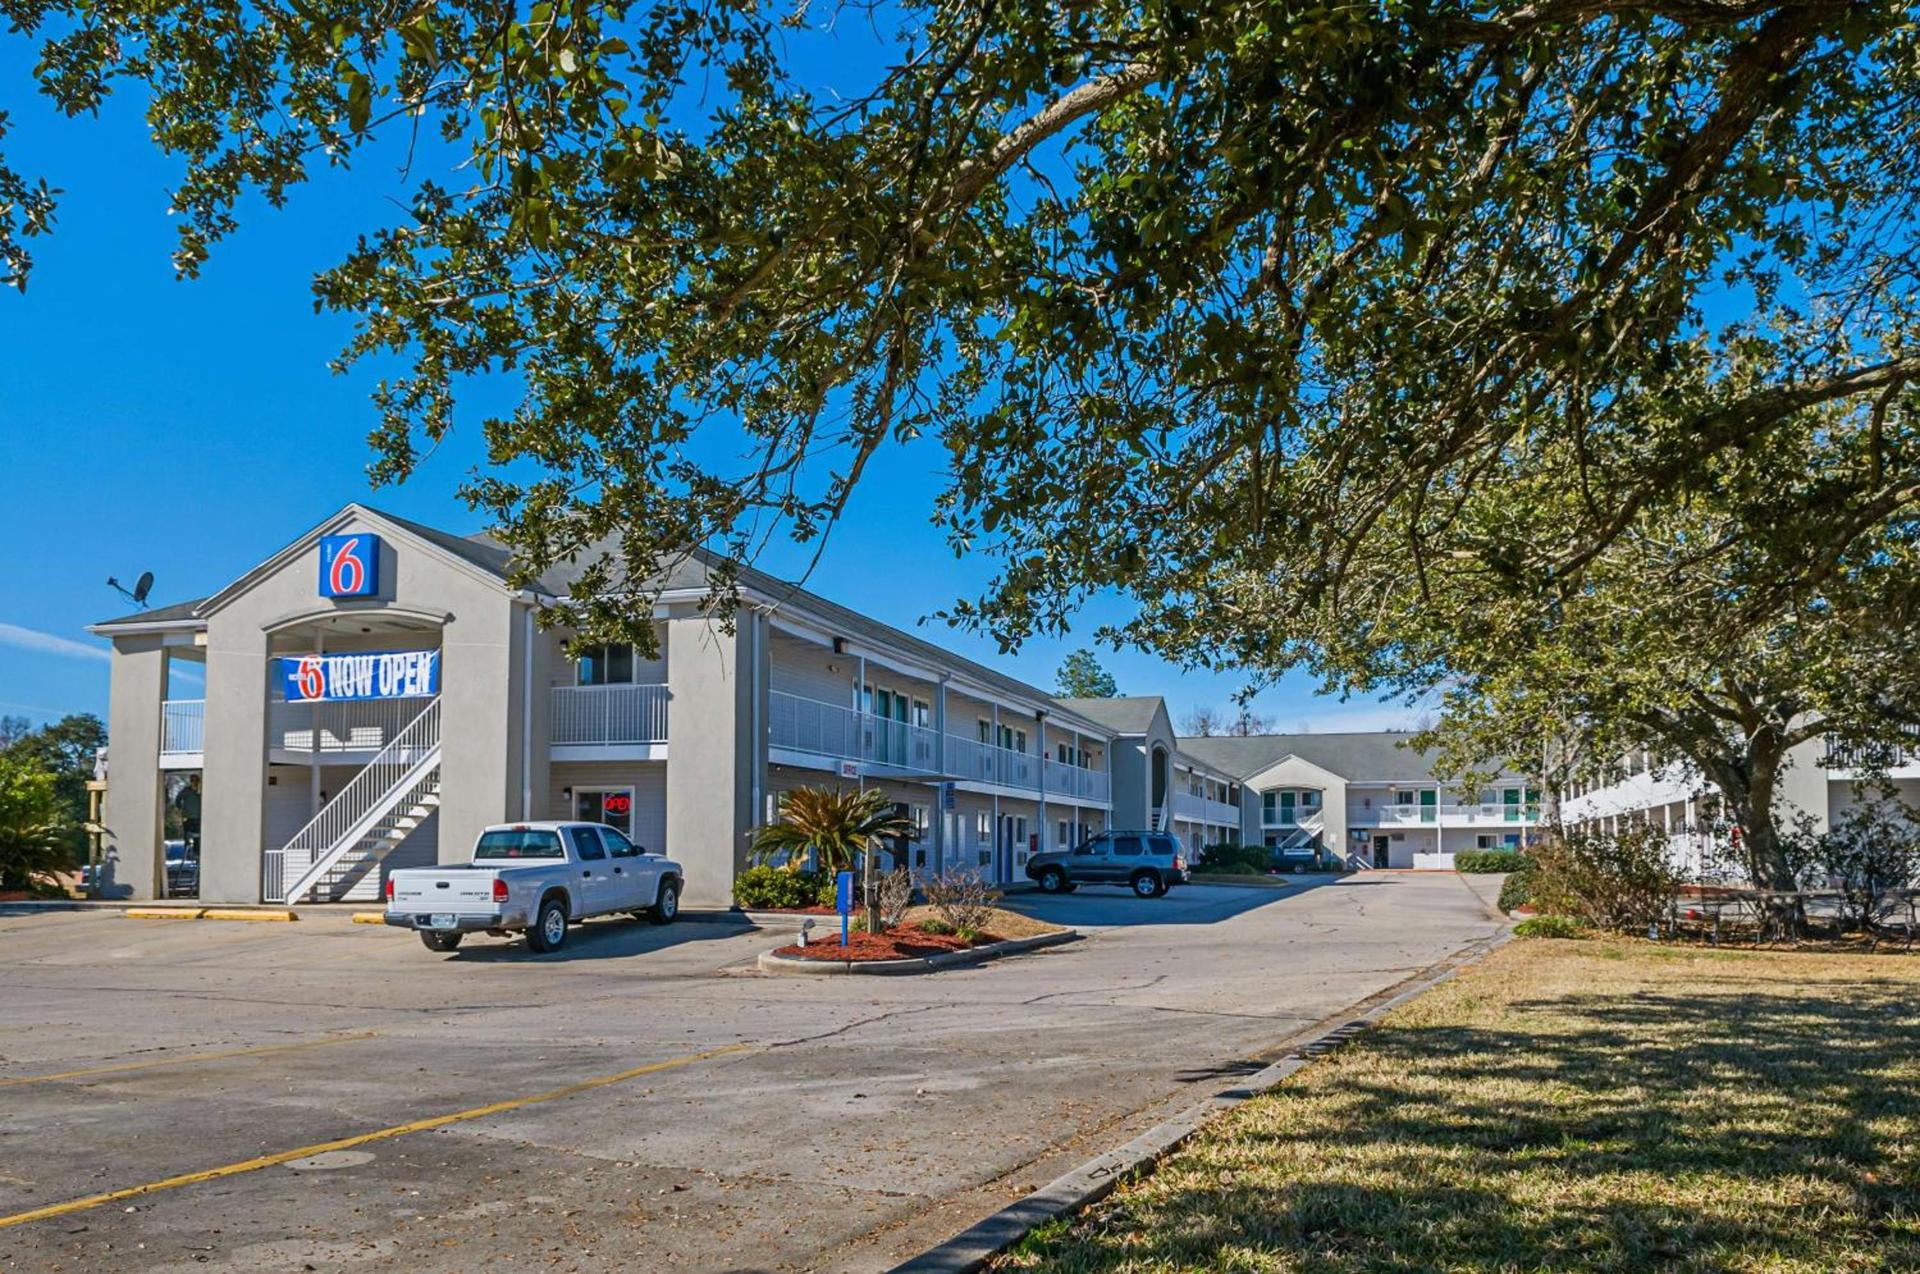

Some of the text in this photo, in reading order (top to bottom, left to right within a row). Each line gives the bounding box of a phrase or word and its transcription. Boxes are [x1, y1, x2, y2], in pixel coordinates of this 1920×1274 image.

[330, 538, 364, 594] 6
[298, 651, 430, 700] 6 NOW OPEN
